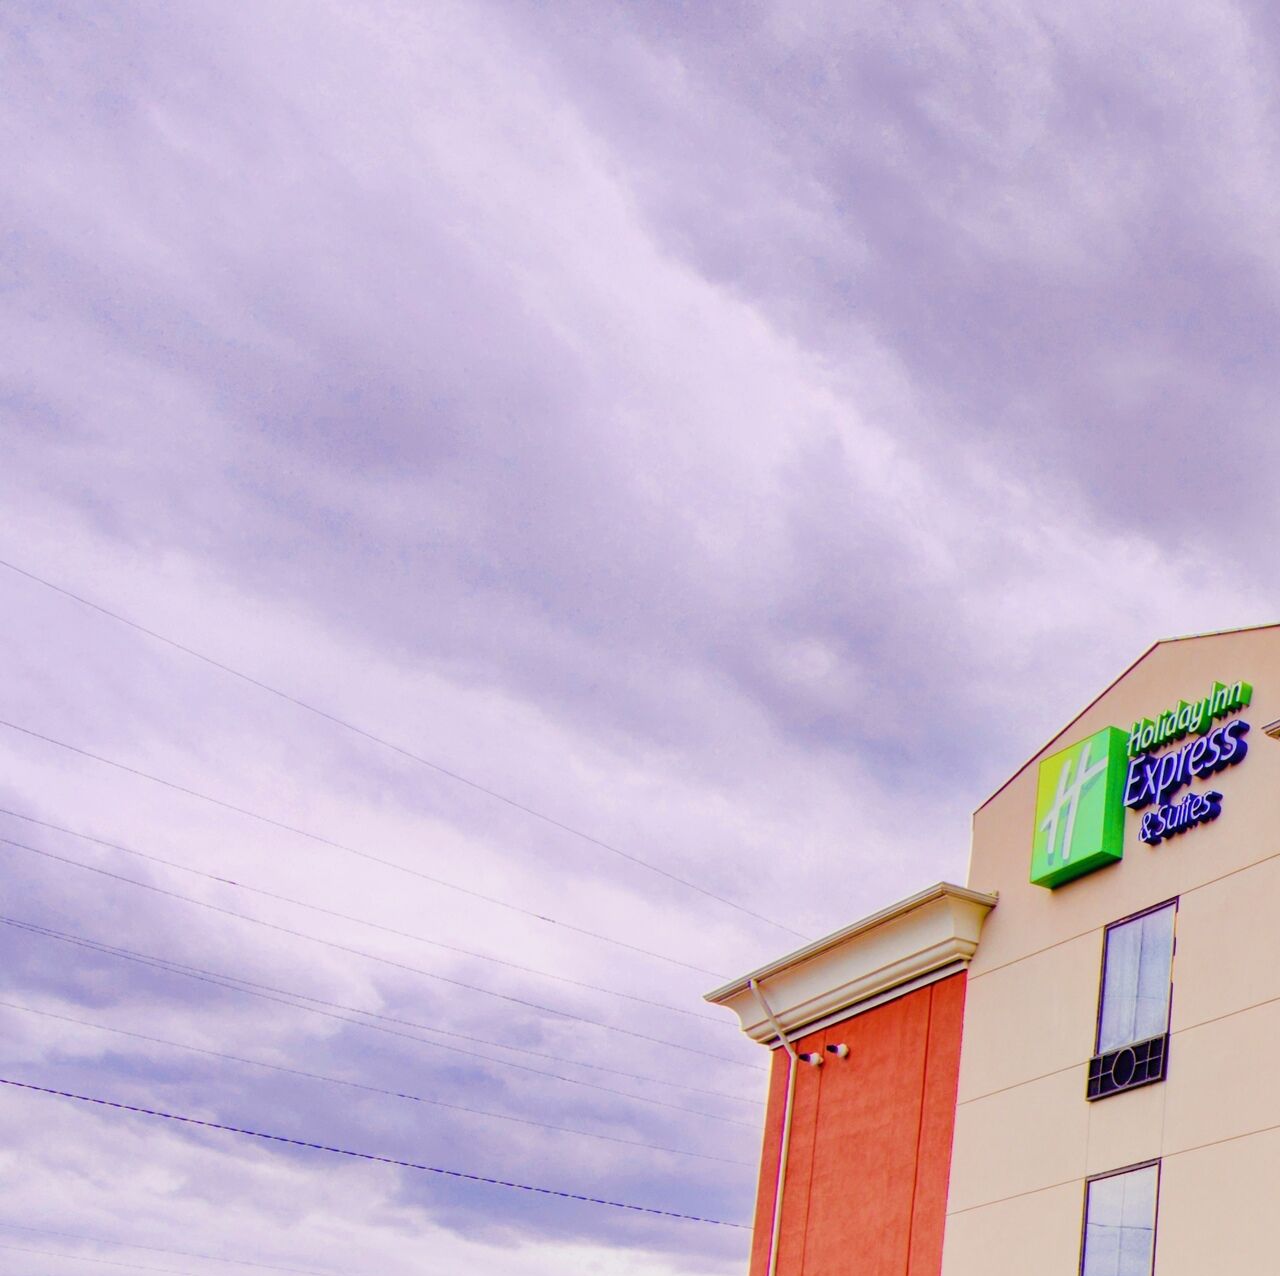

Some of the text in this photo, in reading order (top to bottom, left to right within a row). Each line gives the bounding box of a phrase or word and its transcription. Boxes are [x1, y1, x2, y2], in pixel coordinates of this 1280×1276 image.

[1127, 680, 1247, 757] Holiday Inn
[1123, 719, 1243, 806] Express
[1139, 790, 1217, 843] & Suites
